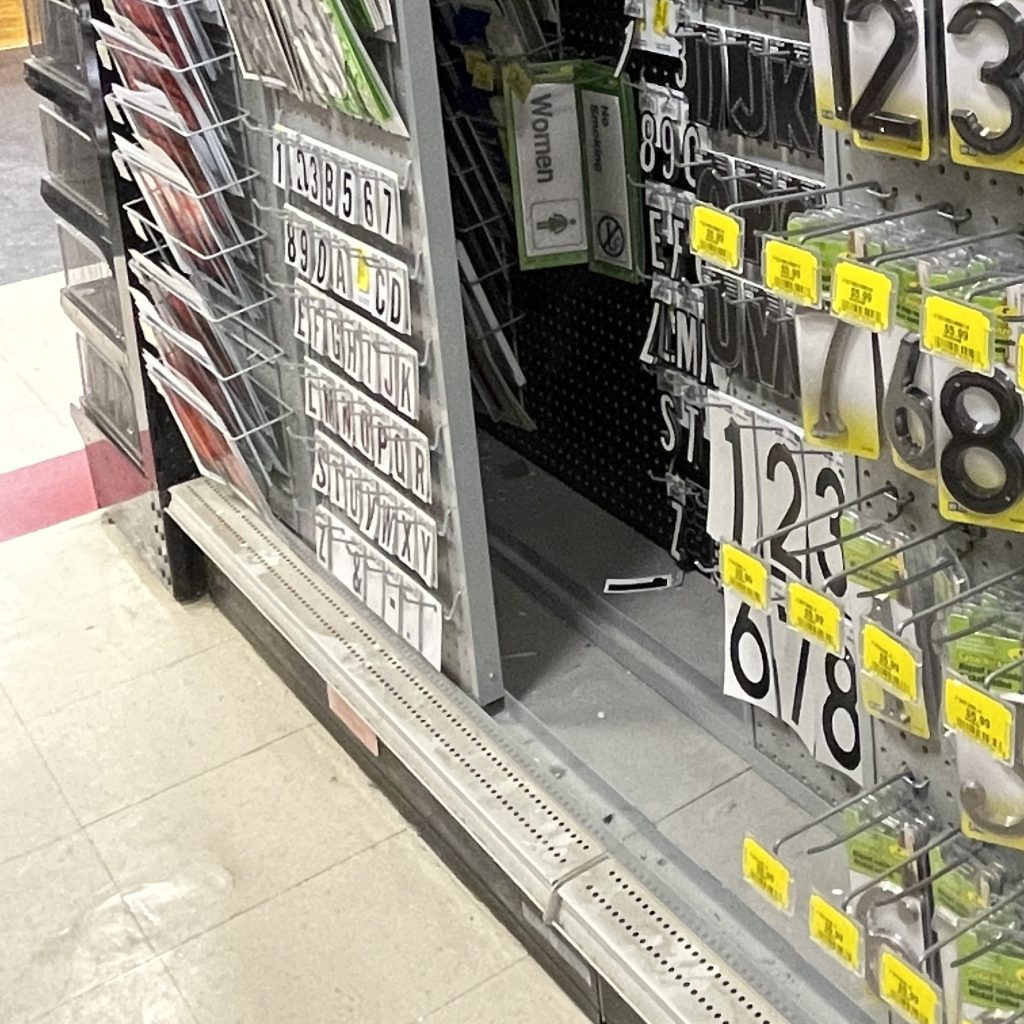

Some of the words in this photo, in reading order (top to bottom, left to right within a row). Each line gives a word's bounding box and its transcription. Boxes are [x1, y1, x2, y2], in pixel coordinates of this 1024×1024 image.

[531, 94, 554, 184] Women
[640, 113, 656, 173] 8
[342, 172, 352, 217] 5
[363, 181, 373, 228] 6
[649, 211, 664, 270] E
[944, 323, 969, 342] $5.99
[882, 332, 934, 471] 6
[724, 417, 744, 546] 1
[766, 443, 802, 579] 2
[822, 646, 862, 771] 8
